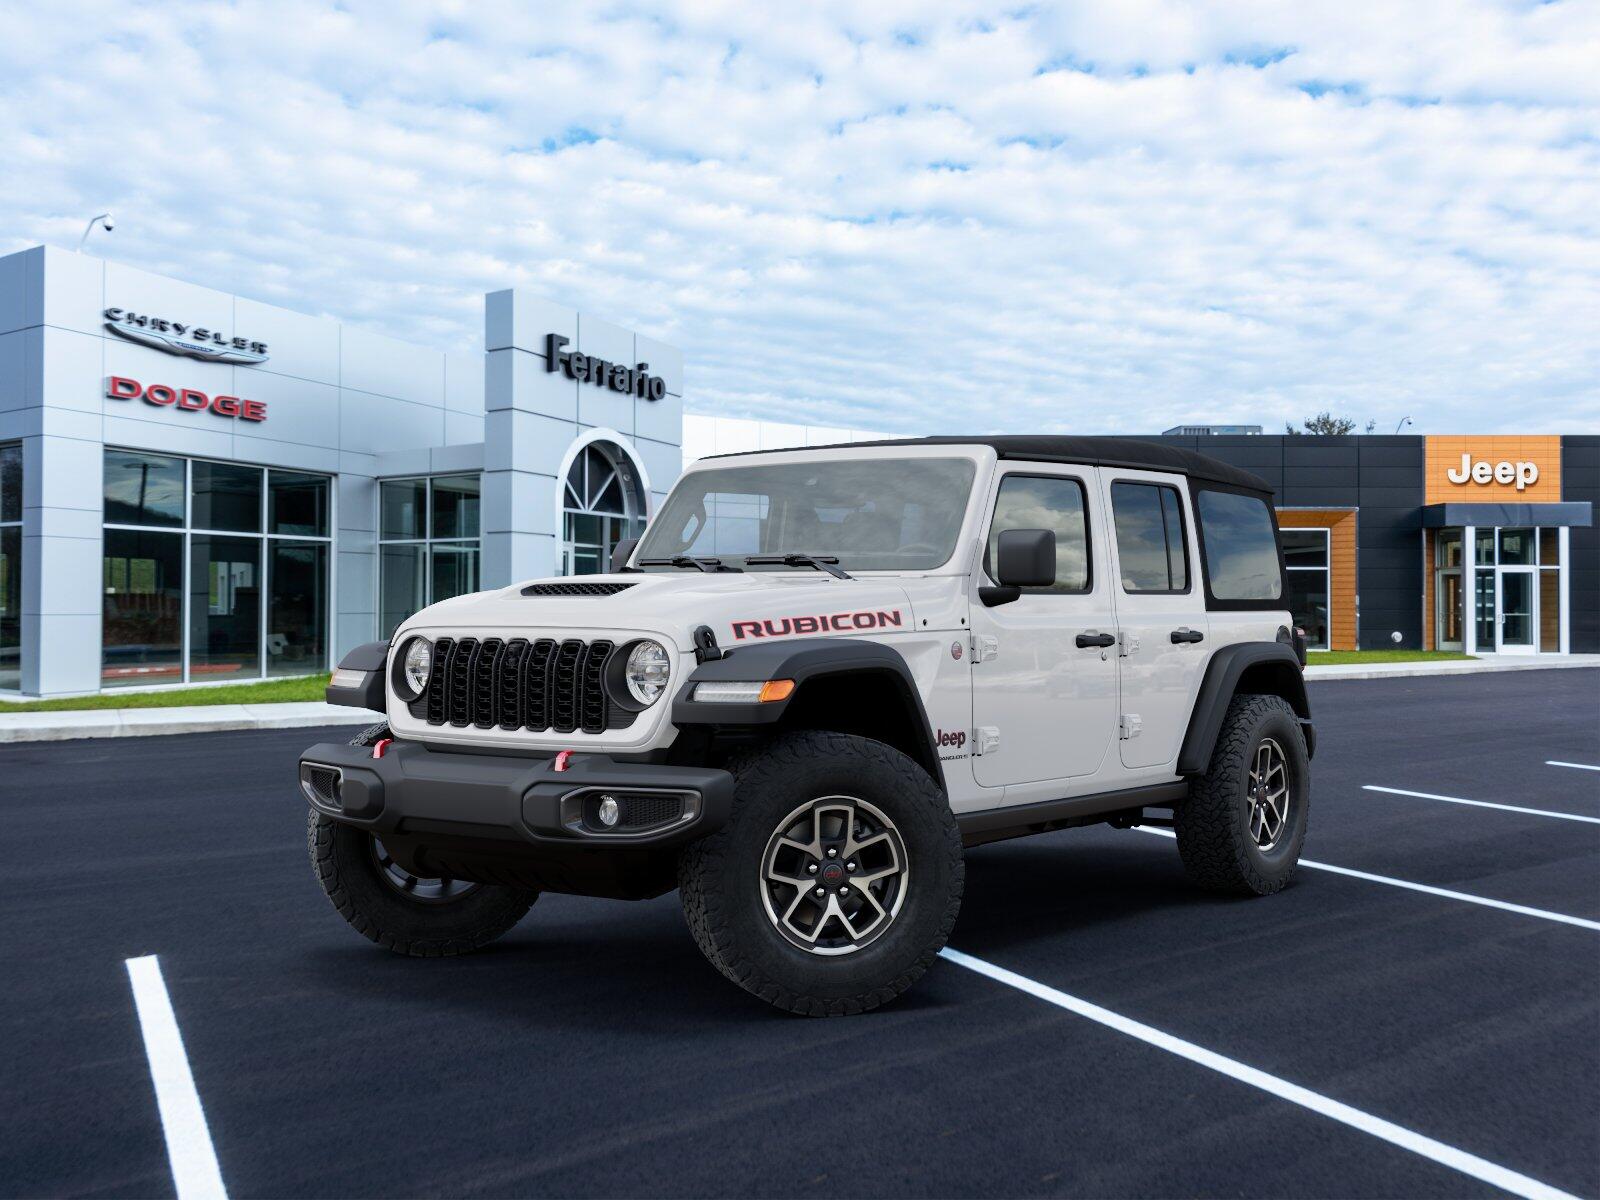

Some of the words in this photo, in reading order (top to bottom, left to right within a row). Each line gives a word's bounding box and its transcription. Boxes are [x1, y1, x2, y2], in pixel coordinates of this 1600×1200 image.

[104, 307, 268, 354] CHRYSLER
[546, 333, 666, 401] Ferrario
[106, 376, 267, 422] DODGE
[1447, 453, 1539, 490] Jeep
[731, 610, 902, 640] RUBICON
[935, 729, 966, 748] Jeep
